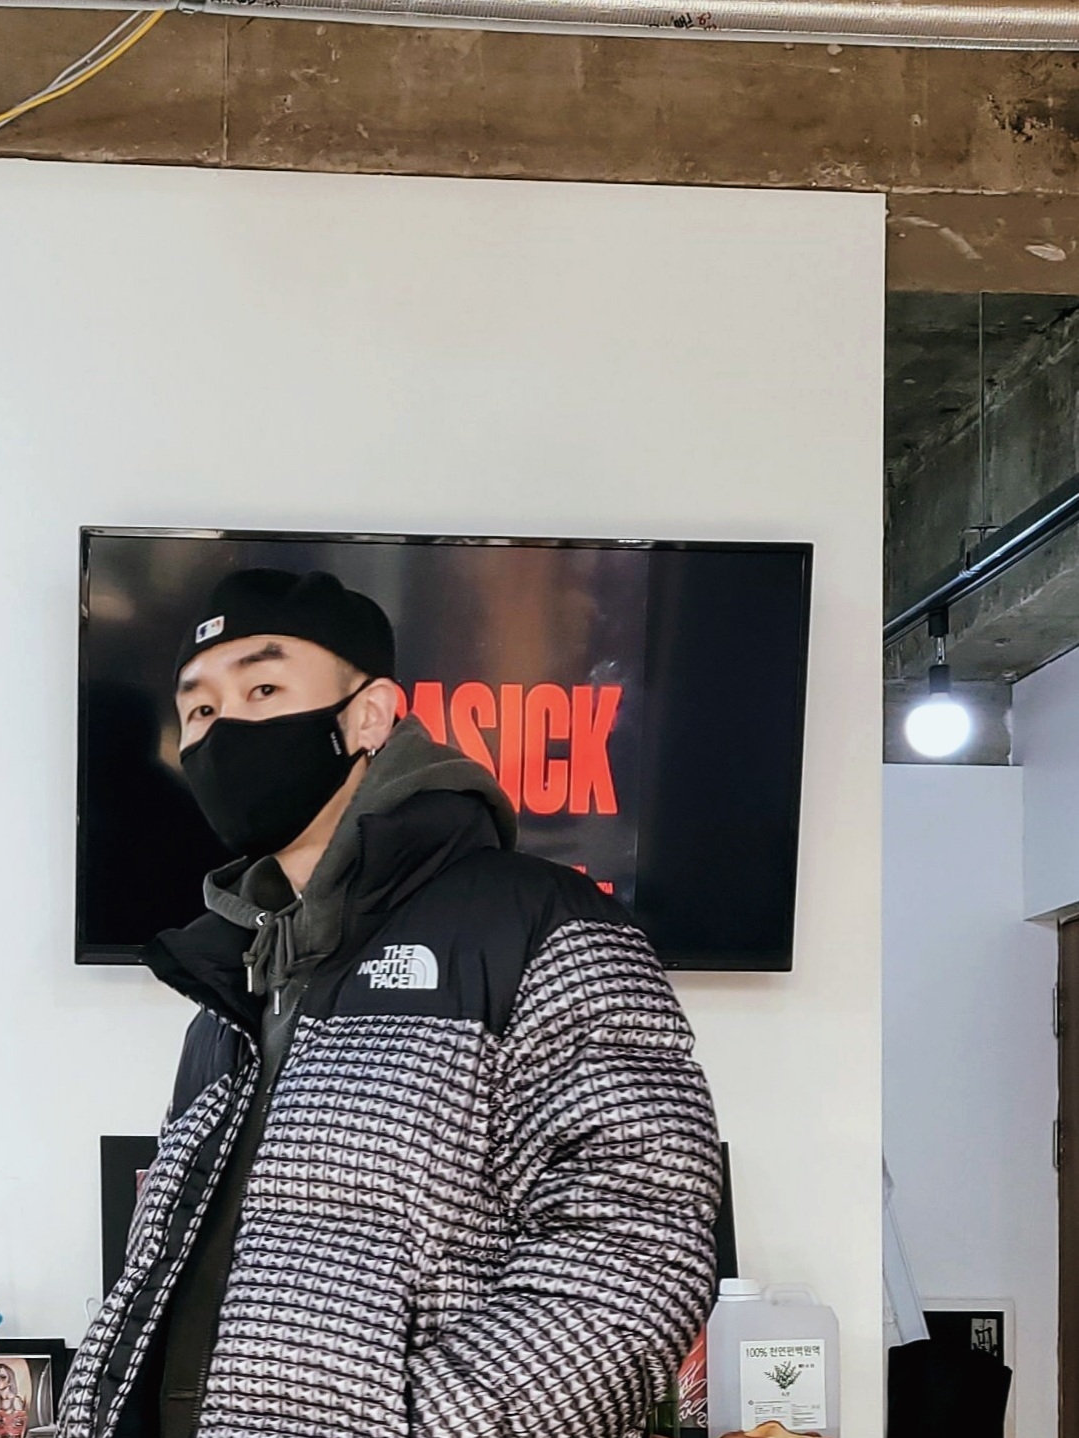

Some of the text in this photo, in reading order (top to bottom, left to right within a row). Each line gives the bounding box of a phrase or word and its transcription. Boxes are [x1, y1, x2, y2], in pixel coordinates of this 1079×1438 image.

[383, 944, 414, 960] THE
[356, 959, 410, 976] NORTH
[369, 973, 410, 989] FACE
[745, 1347, 768, 1358] 100%
